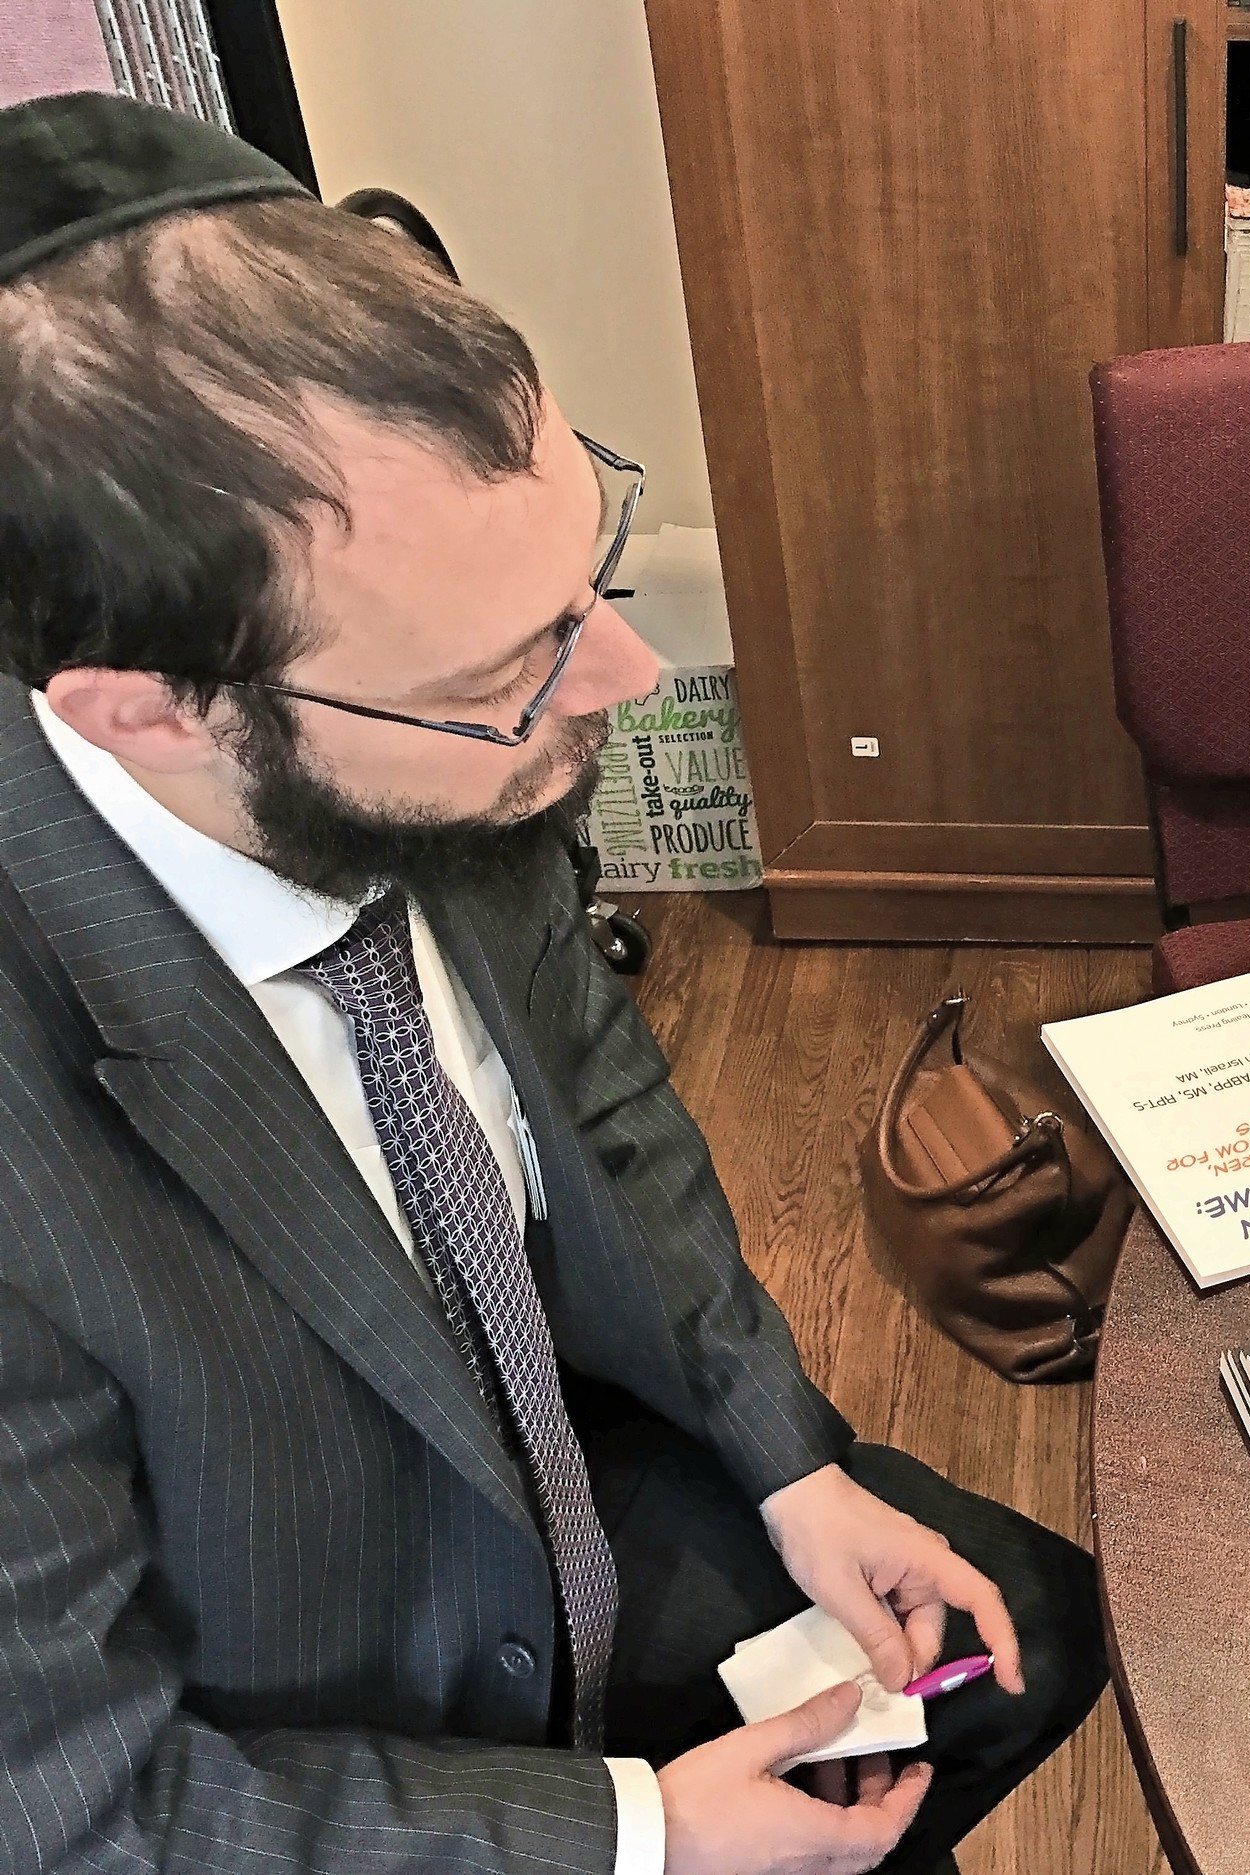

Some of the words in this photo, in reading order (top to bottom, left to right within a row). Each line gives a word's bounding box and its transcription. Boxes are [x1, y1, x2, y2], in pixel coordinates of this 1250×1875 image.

[674, 674, 730, 703] DAIRY
[617, 696, 740, 743] bakery
[658, 731, 714, 743] SELECTION
[664, 747, 746, 784] VALUE
[632, 735, 665, 818] take-out
[669, 786, 753, 820] quality
[650, 819, 754, 855] PRODUCE
[600, 858, 661, 883] airy
[668, 855, 762, 880] fresh
[1211, 1003, 1243, 1016] London
[1172, 1014, 1206, 1027] Sydney
[1195, 1021, 1222, 1032] Press
[1175, 1071, 1199, 1083] MA
[1199, 1058, 1244, 1076] Israeli,
[1208, 1072, 1250, 1091] ABPP,
[1132, 1094, 1177, 1112] RPT-S
[1178, 1086, 1208, 1100] MS,
[1167, 1150, 1209, 1171] FOR
[1196, 1187, 1250, 1218] ME:
